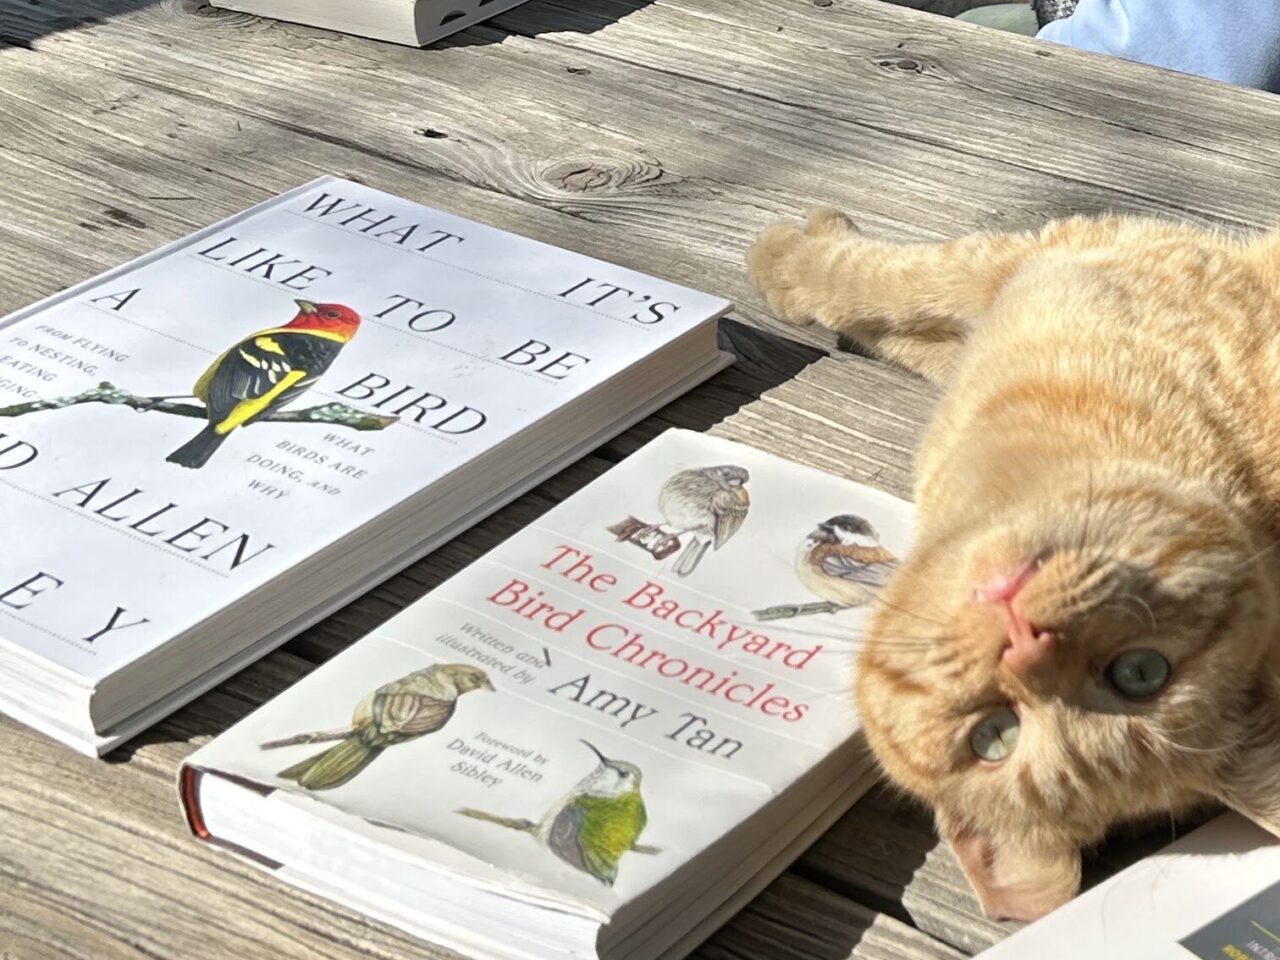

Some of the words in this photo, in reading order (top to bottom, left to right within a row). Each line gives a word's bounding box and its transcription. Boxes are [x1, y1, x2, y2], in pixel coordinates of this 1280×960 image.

[303, 193, 465, 252] WHAT
[557, 278, 681, 325] IT'S
[197, 237, 333, 290] LIKE
[374, 294, 457, 333] TO
[499, 339, 591, 380] BE
[8, 337, 28, 347] TO
[28, 343, 98, 376] NESTING,
[35, 325, 73, 341] FROM
[72, 337, 131, 363] FLYING
[90, 288, 142, 311] A
[335, 373, 488, 435] BIRD
[0, 355, 58, 382] EATING
[0, 376, 38, 399] GING
[275, 440, 329, 464] BIRDS
[328, 461, 368, 479] ARE
[323, 432, 375, 457] WHAT
[246, 453, 304, 483] DOING,
[306, 480, 342, 496] AND
[248, 479, 290, 500] WHY
[0, 433, 38, 470] D
[52, 478, 275, 569] ALLEN
[540, 545, 618, 593] The
[622, 581, 823, 671] Backyard
[435, 633, 515, 674] illustrated
[513, 666, 536, 684] by
[460, 622, 515, 654] Written
[515, 650, 550, 670] and
[486, 578, 585, 633] Bird
[585, 622, 810, 724] Chronicles
[548, 674, 659, 728] Amy
[666, 712, 744, 760] Tan
[447, 738, 498, 764] David
[496, 757, 543, 783] Allen
[474, 732, 534, 758] Foreword
[532, 752, 549, 767] by
[450, 760, 502, 788] Sibley
